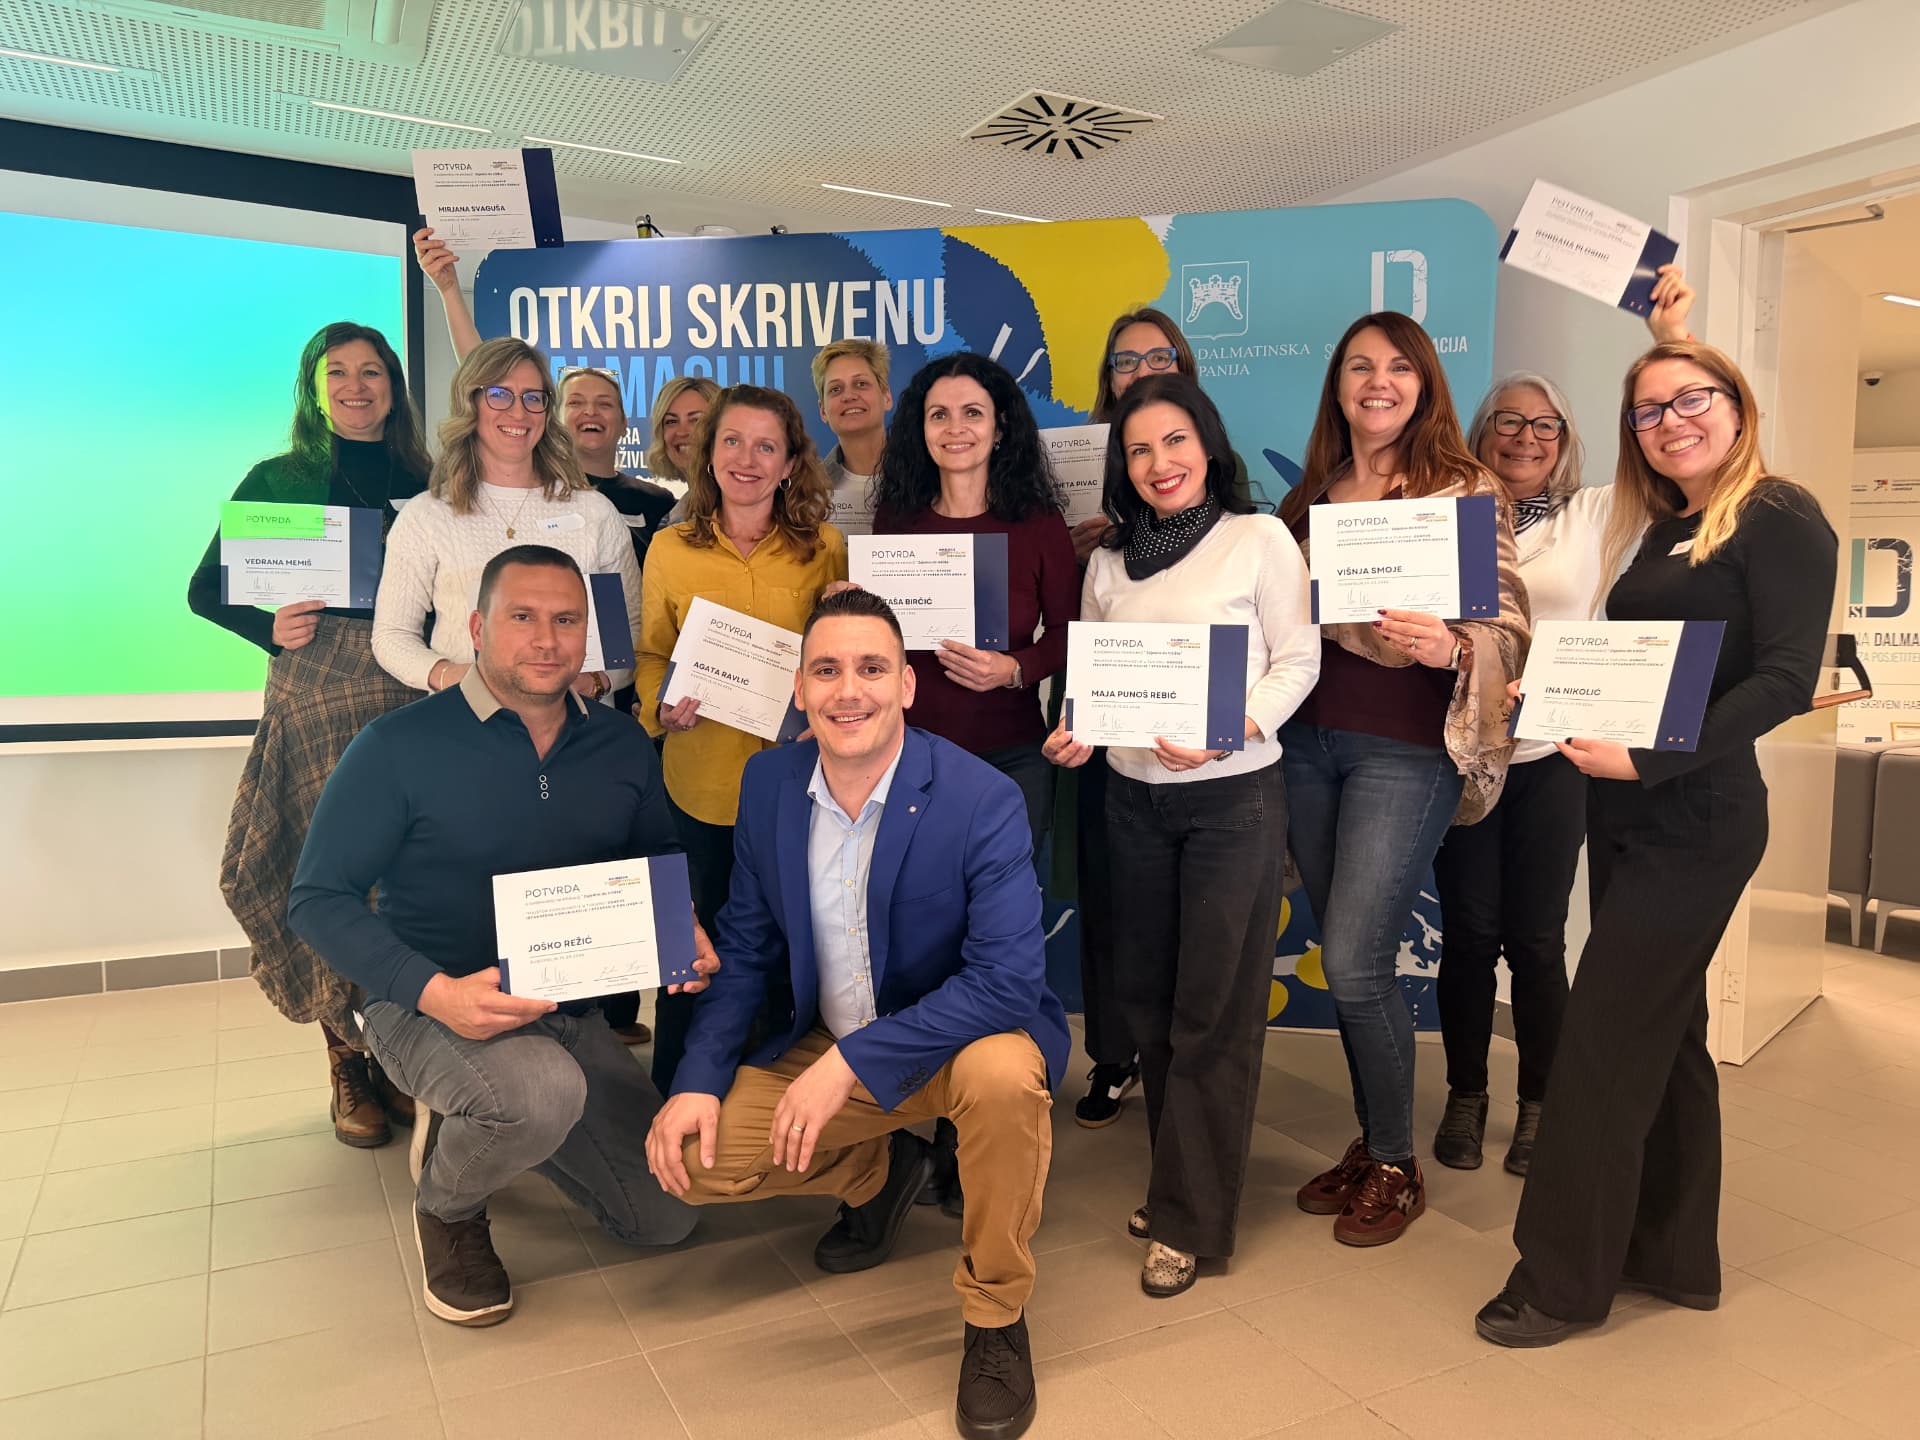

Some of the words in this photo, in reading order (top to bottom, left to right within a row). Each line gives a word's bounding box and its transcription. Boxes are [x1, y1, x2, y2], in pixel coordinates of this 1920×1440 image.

[433, 163, 472, 171] POTVRDA
[509, 285, 671, 349] OTKRIJ
[687, 278, 945, 349] SKRIVENU
[1051, 439, 1091, 448] POTVRDA
[246, 515, 291, 525] POTVRDA
[1337, 516, 1389, 528] POTVRDA
[872, 550, 916, 559] POTVRDA
[245, 558, 284, 566] VEDRANA
[285, 558, 312, 567] MEMIŠ
[1337, 567, 1369, 576] VIŠNJA
[1371, 565, 1403, 575] SMOJE
[710, 618, 752, 640] POTVRDA
[1094, 638, 1144, 648] POTVRDA
[1559, 636, 1609, 647] POTVRDA
[693, 661, 721, 676] AGATA
[1091, 690, 1115, 698] MAJA
[1117, 689, 1149, 699] PUNOŠ
[1150, 690, 1177, 699] REBIĆ
[1545, 686, 1561, 694] INA
[525, 884, 580, 899] POTVRDA
[528, 939, 561, 953] JOŠKO
[564, 935, 593, 948] REŽIĆ
